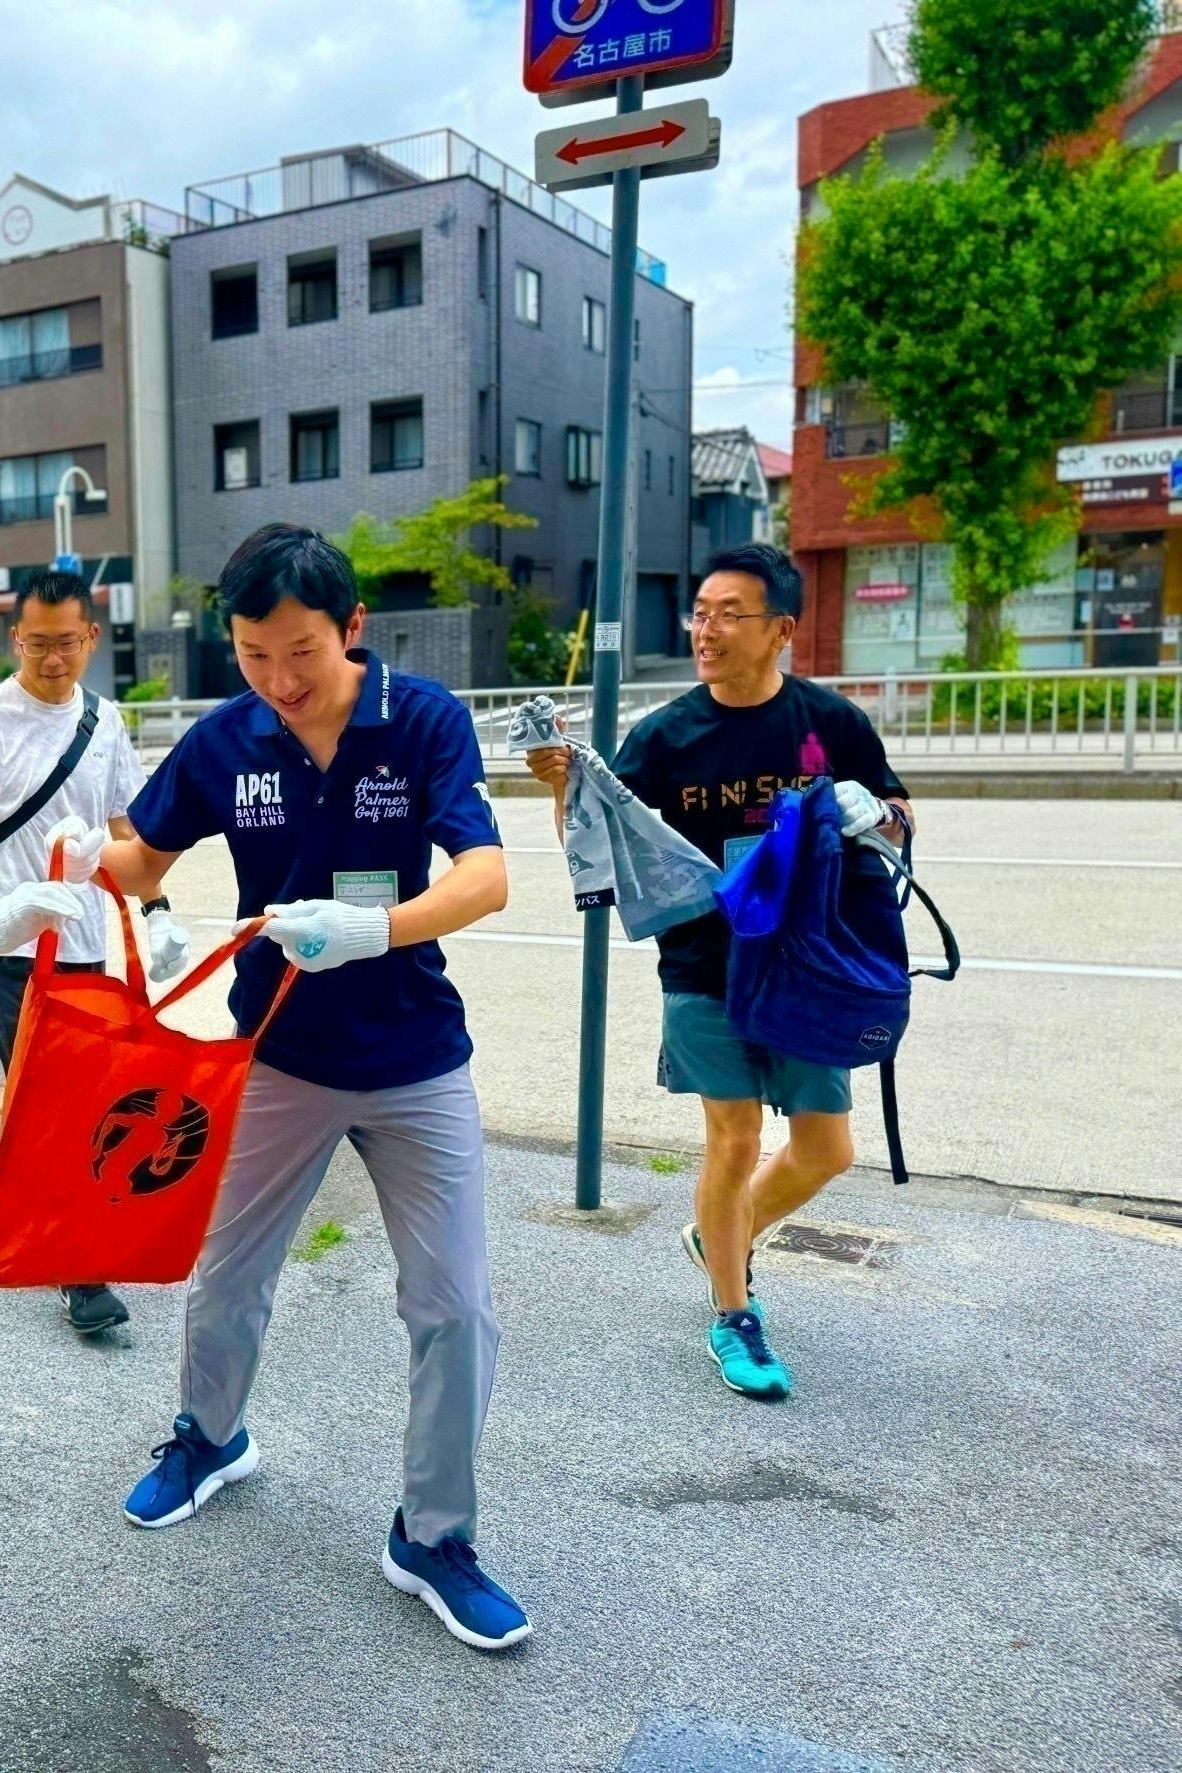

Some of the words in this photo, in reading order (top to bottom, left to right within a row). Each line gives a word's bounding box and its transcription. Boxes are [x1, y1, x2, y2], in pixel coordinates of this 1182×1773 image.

[573, 29, 672, 68] 名古屋市
[1102, 449, 1182, 470] TOKUG
[381, 690, 389, 719] ARNOLD
[235, 771, 282, 807] AP61
[354, 776, 409, 793] Arnold
[354, 791, 410, 807] Palmer
[236, 807, 256, 818] BAY
[260, 805, 284, 817] HILL
[355, 806, 381, 823] Golf
[383, 806, 409, 818] 1961
[236, 815, 286, 828] ORLAND
